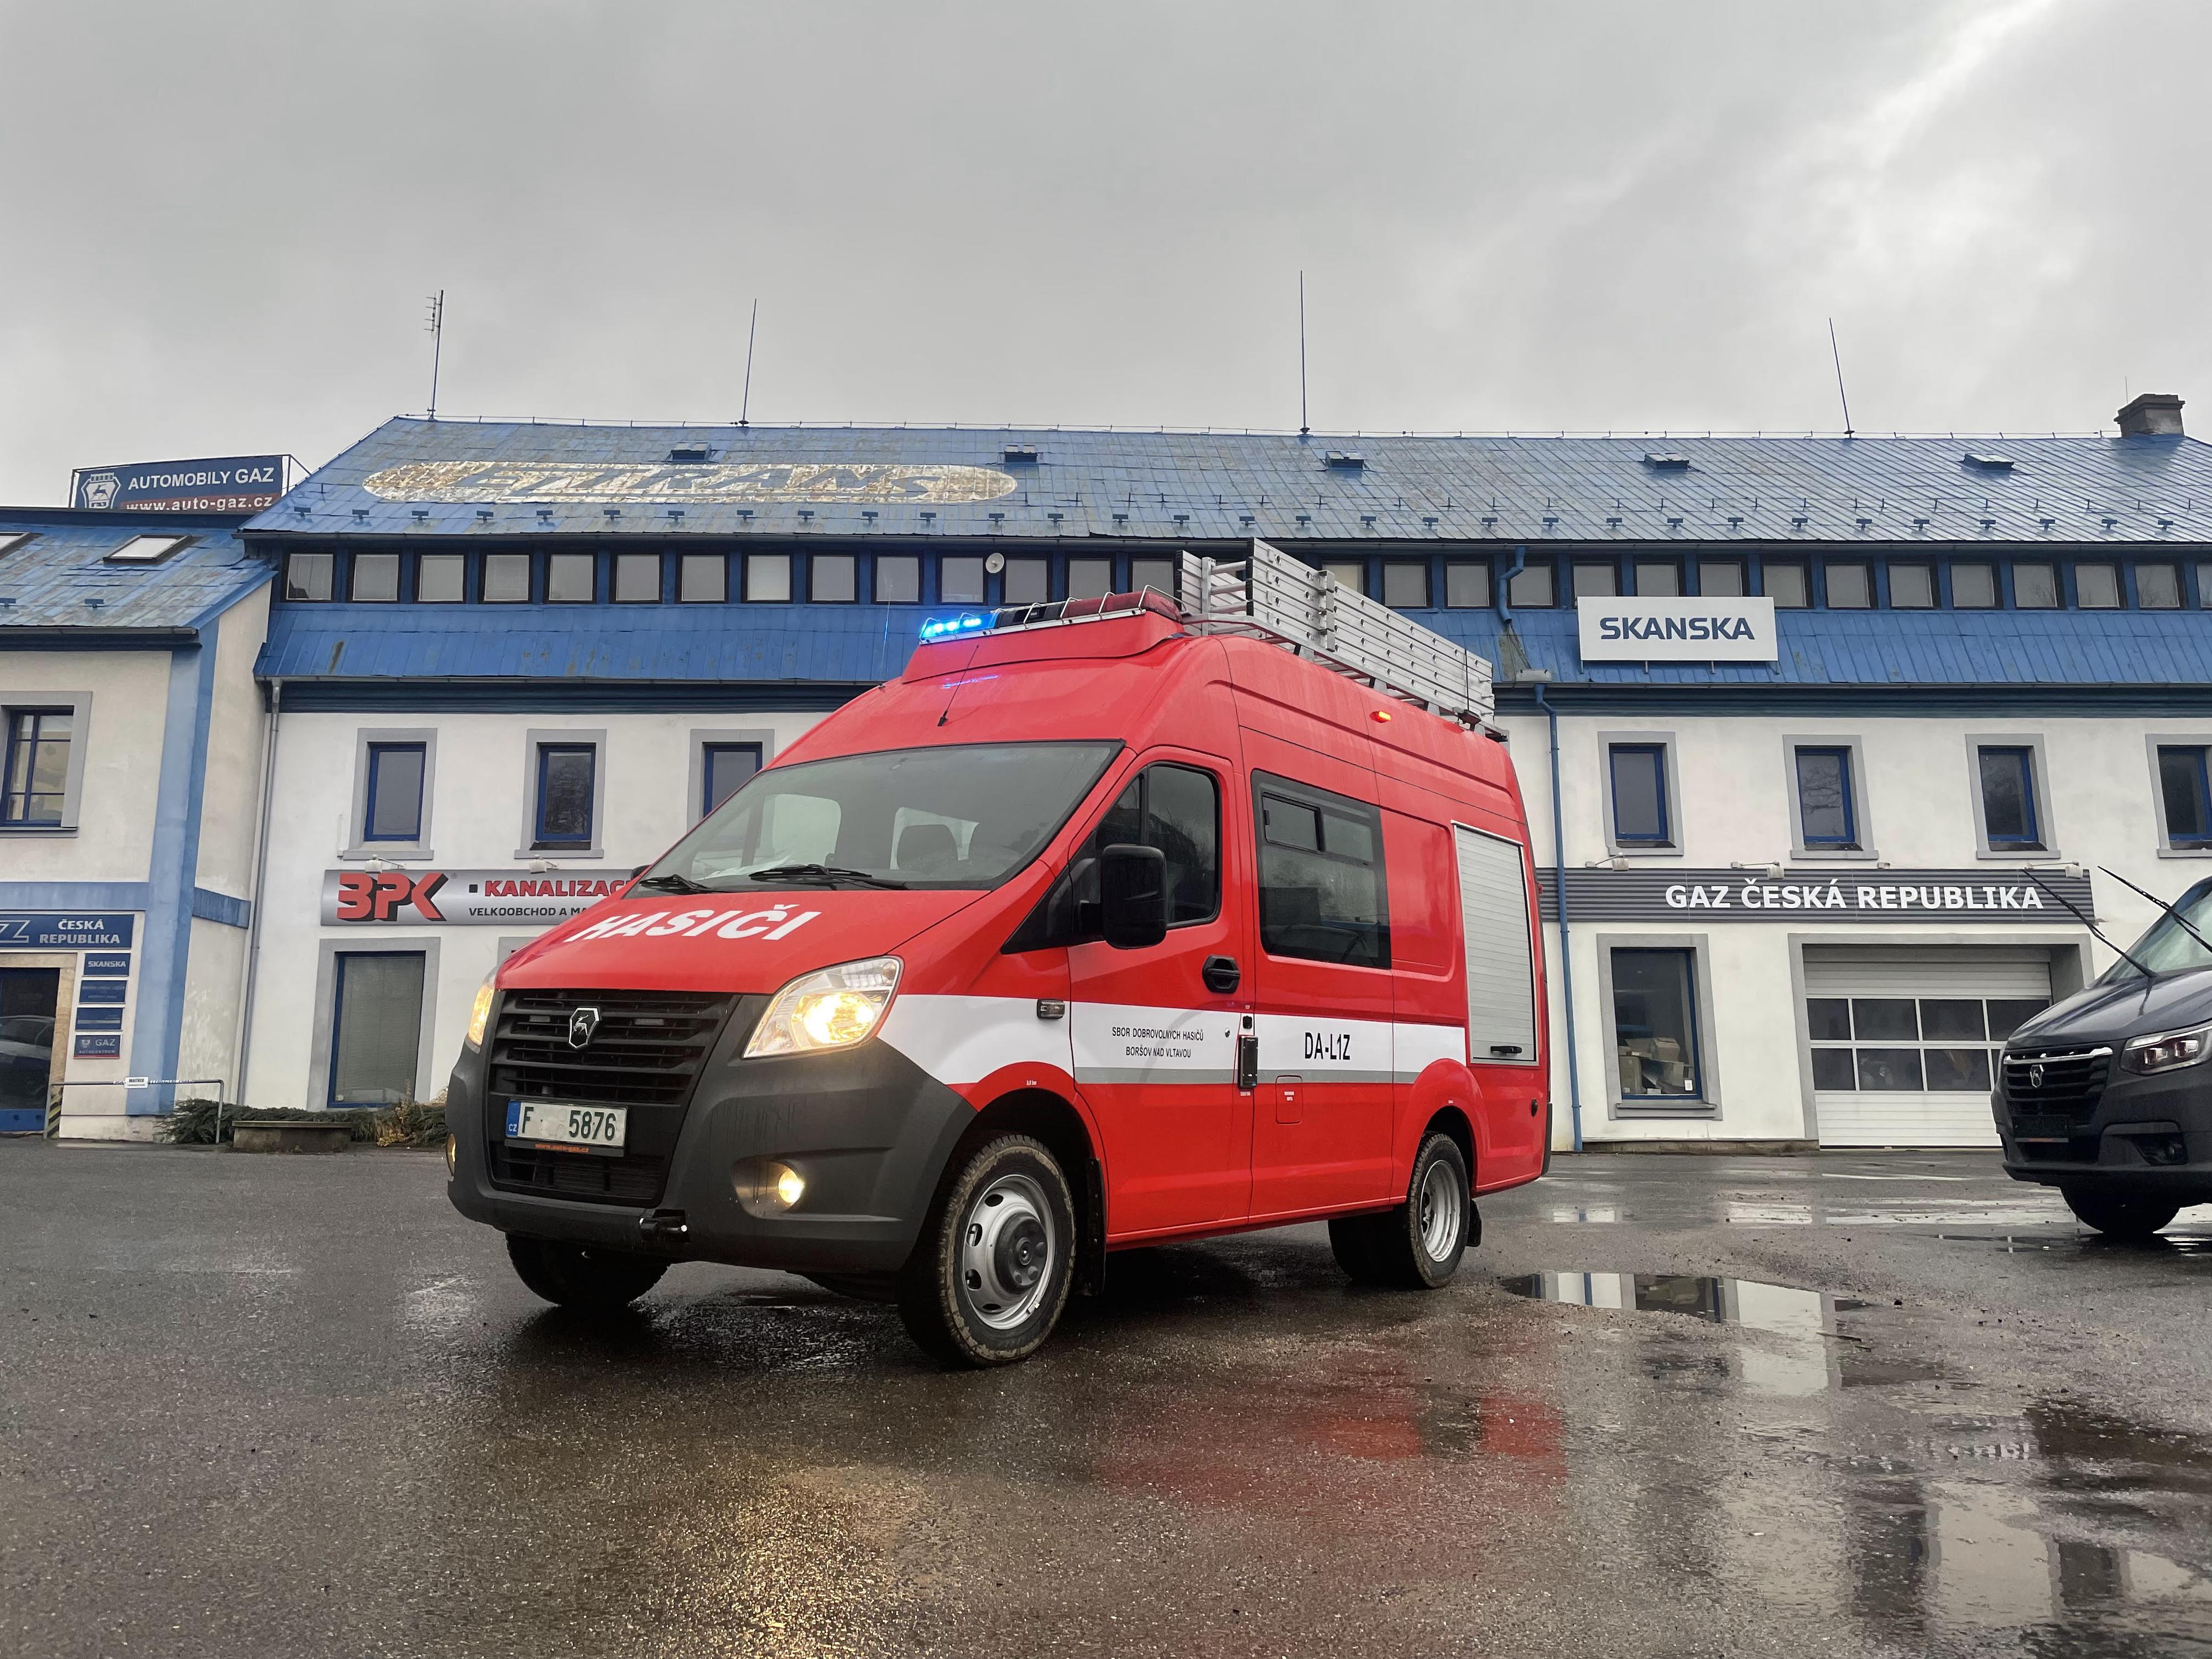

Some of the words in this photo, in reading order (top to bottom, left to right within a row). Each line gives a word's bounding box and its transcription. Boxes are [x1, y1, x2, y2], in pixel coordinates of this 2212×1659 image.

[128, 471, 231, 490] AUTOMOBILY
[235, 467, 274, 484] GAZ
[126, 497, 273, 511] www.auto-gaz.cz
[1600, 617, 1755, 640] SKANSKA
[484, 880, 632, 896] KANALIZAC
[1665, 885, 1731, 909] GAZ
[1741, 878, 1847, 909] ČESKÁ
[1857, 886, 2044, 909] REPUBLIKA
[337, 873, 448, 921] BPK
[469, 907, 556, 916] VELKOOBCHOD
[571, 907, 587, 916] M
[58, 919, 105, 930] ČESKÁ
[562, 904, 822, 943] HASIČI
[39, 934, 121, 943] REPUBLIKA
[1112, 1027, 1130, 1037] SBOR
[1133, 1028, 1181, 1040] DOBROVOLNÝCH
[1183, 1029, 1204, 1041] HASIČŮ
[1126, 1045, 1151, 1056] BORŠOV
[1153, 1047, 1164, 1057] NAD
[1166, 1048, 1191, 1058] VLTAVOU
[1305, 1032, 1350, 1060] DA-L1Z
[509, 1124, 517, 1132] CZ
[522, 1107, 534, 1134] F
[569, 1110, 616, 1141] 5876
